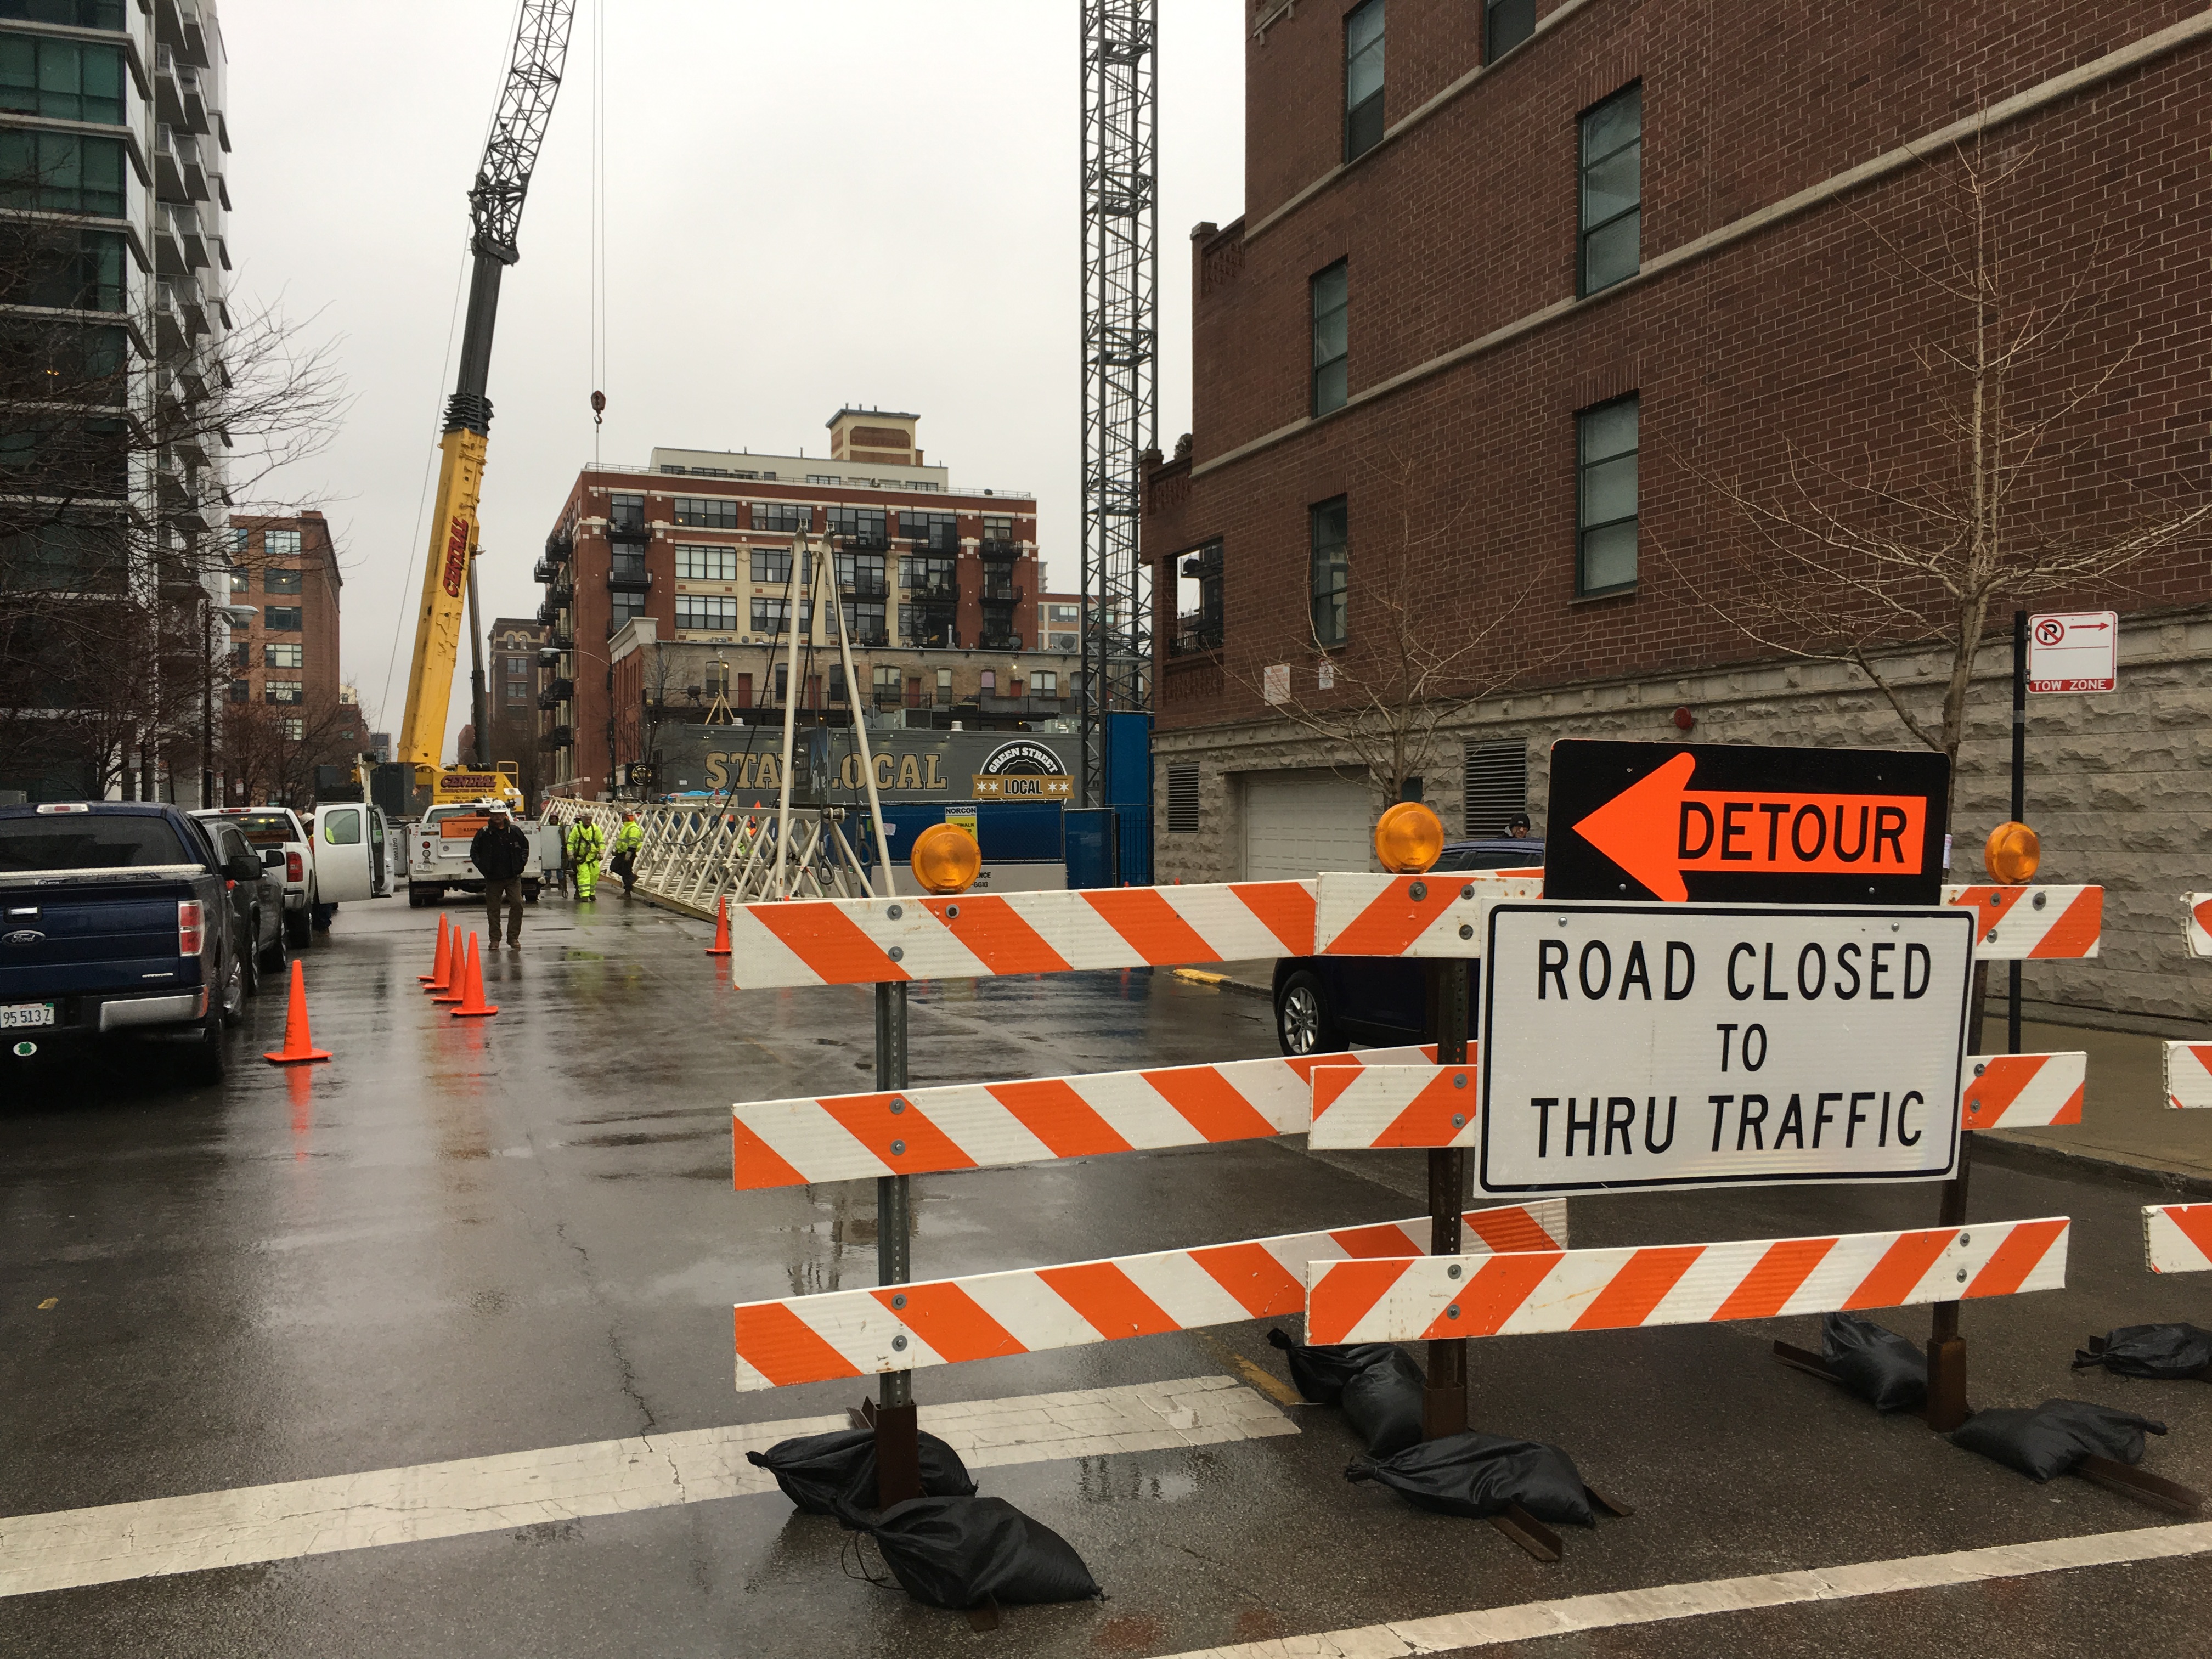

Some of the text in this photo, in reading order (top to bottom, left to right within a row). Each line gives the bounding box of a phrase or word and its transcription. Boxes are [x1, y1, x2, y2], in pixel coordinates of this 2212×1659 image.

[443, 515, 469, 598] CENTRAL
[2034, 679, 2106, 691] TOW ZONE
[989, 747, 1058, 773] GREEN STREET
[441, 775, 497, 788] CENTRAL
[1005, 779, 1043, 795] LOCAL
[1678, 802, 1906, 864] DETOUR
[11, 933, 36, 943] Ford
[1538, 939, 1931, 1001] ROAD CLOSED
[1717, 1023, 1767, 1072] TO
[1531, 1090, 1924, 1157] THRU TRAFFIC
